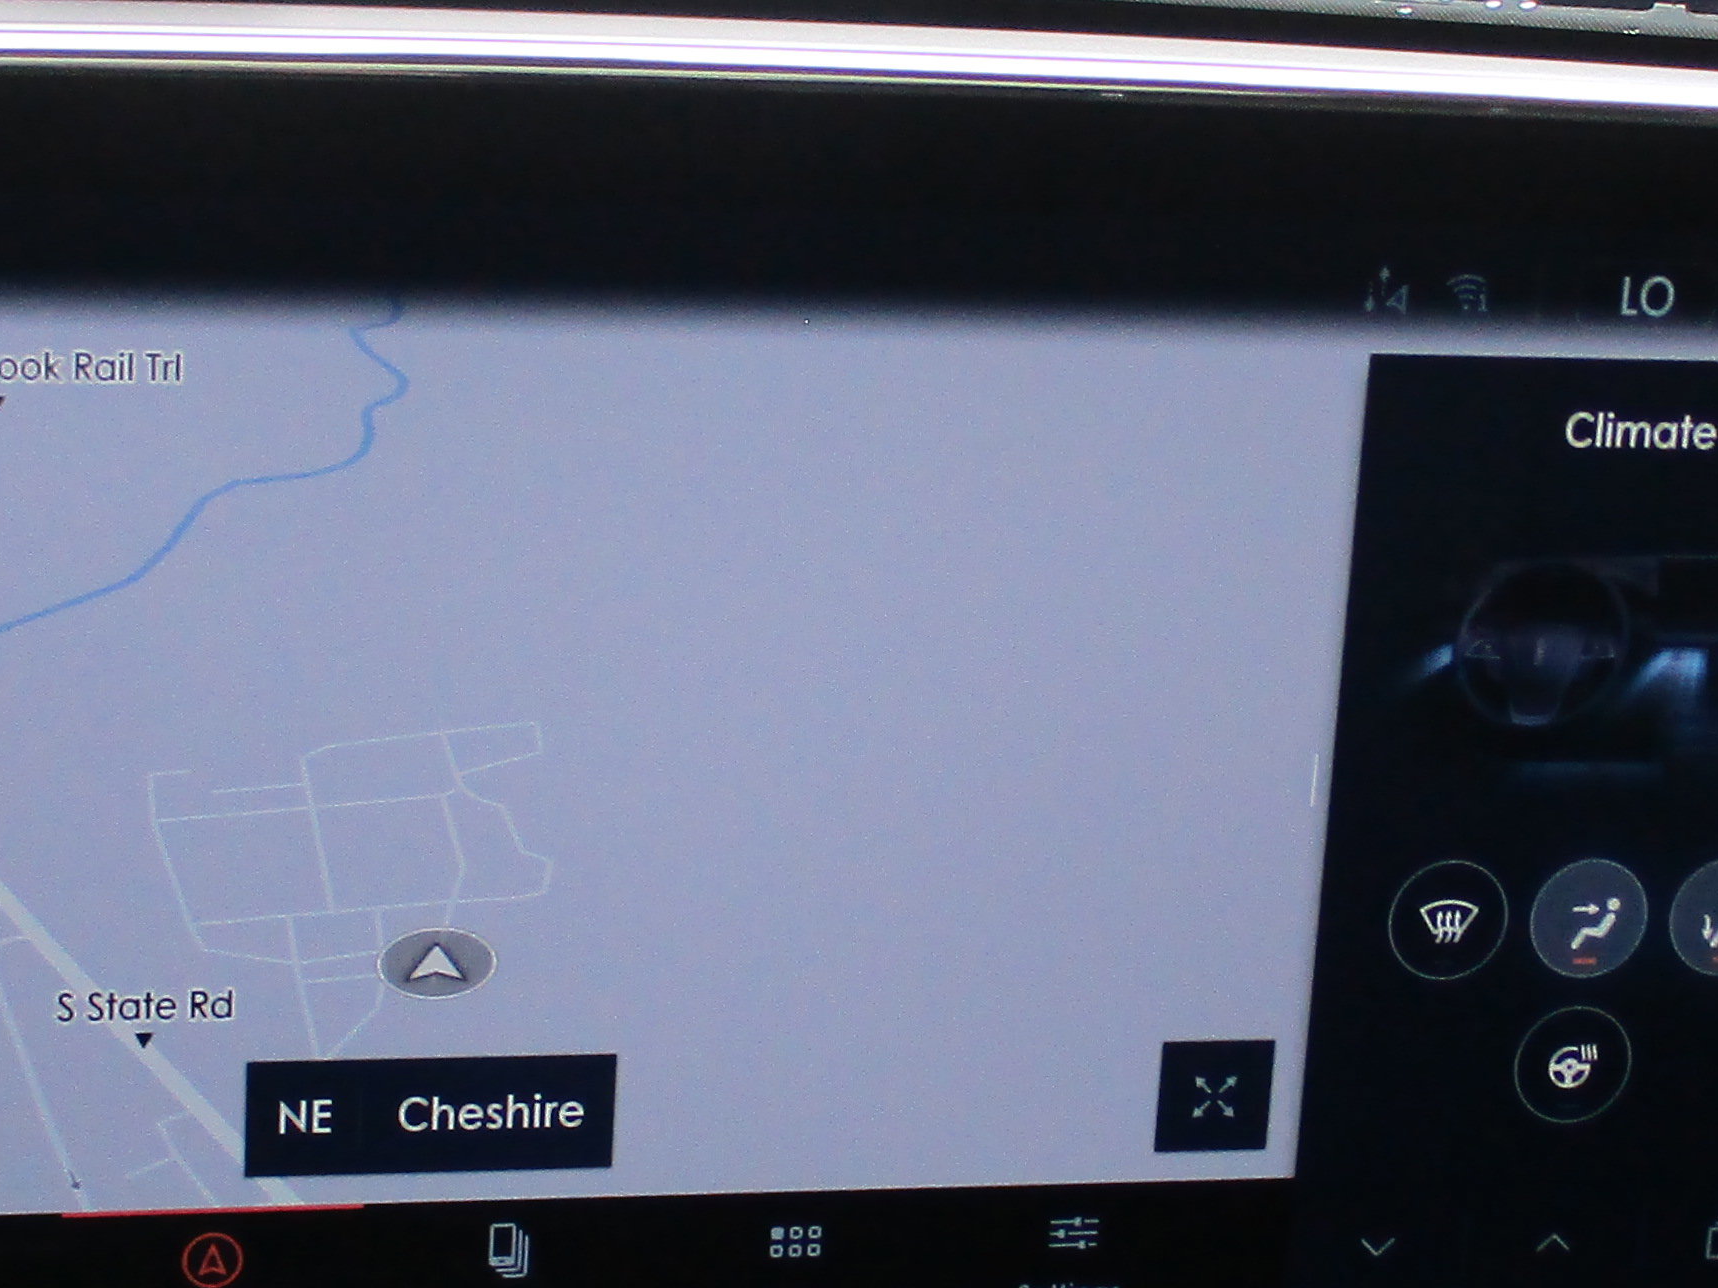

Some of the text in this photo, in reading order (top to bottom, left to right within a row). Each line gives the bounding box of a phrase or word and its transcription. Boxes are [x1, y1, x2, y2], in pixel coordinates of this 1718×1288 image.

[1620, 275, 1675, 318] LO
[75, 352, 134, 381] Rail
[146, 353, 181, 381] Trl
[1565, 411, 1718, 451] Climate
[57, 990, 234, 1023] S State Rd
[278, 1093, 585, 1135] NE Cheshire
